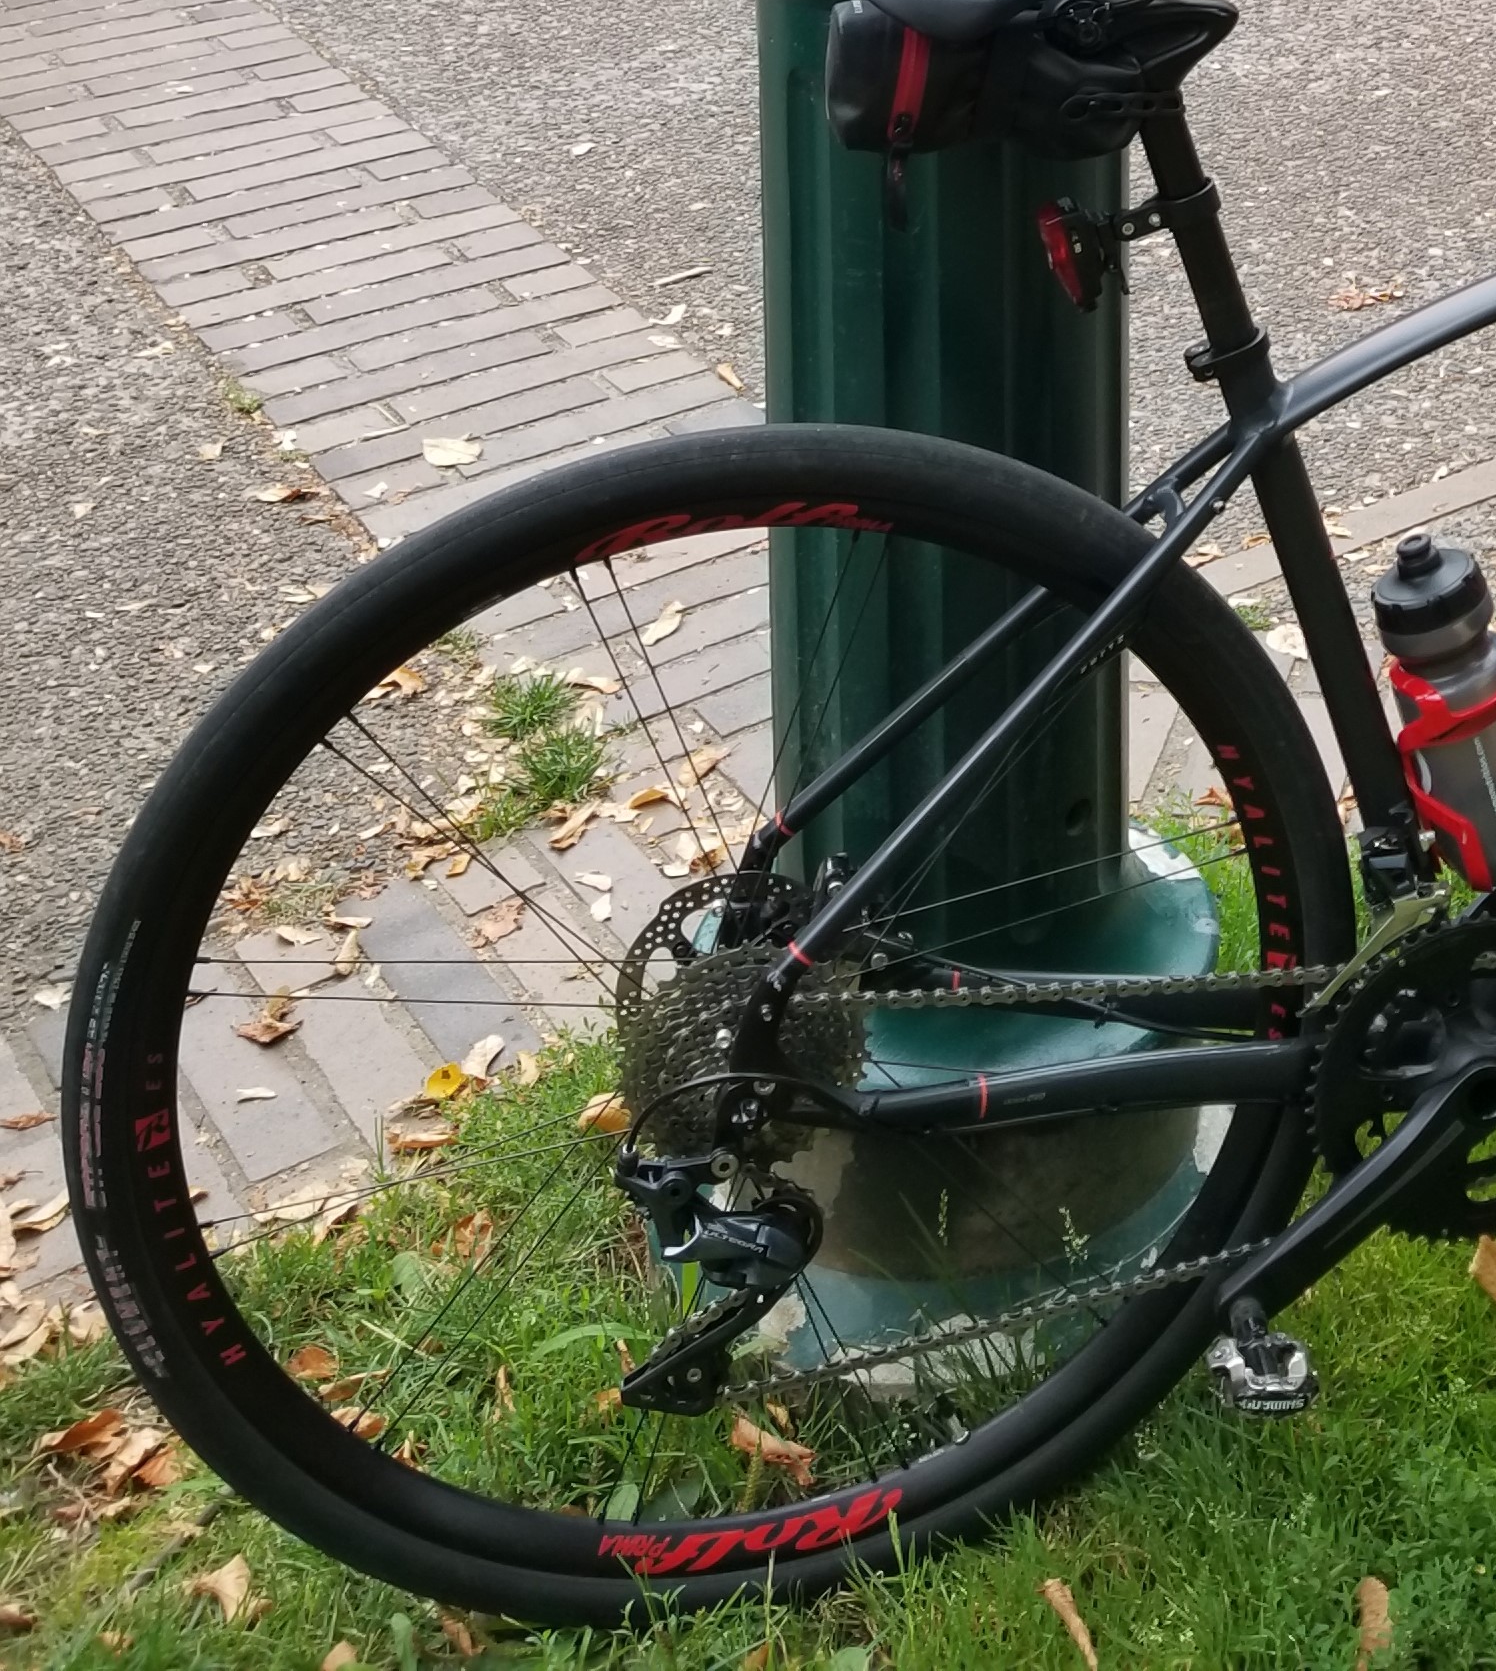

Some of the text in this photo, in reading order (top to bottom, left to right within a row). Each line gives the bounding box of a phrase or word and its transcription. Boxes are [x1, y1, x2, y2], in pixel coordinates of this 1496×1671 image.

[1216, 744, 1291, 941] HYALITE
[146, 1159, 248, 1366] HYALITE
[597, 1488, 904, 1575] Rolf PRIMA
